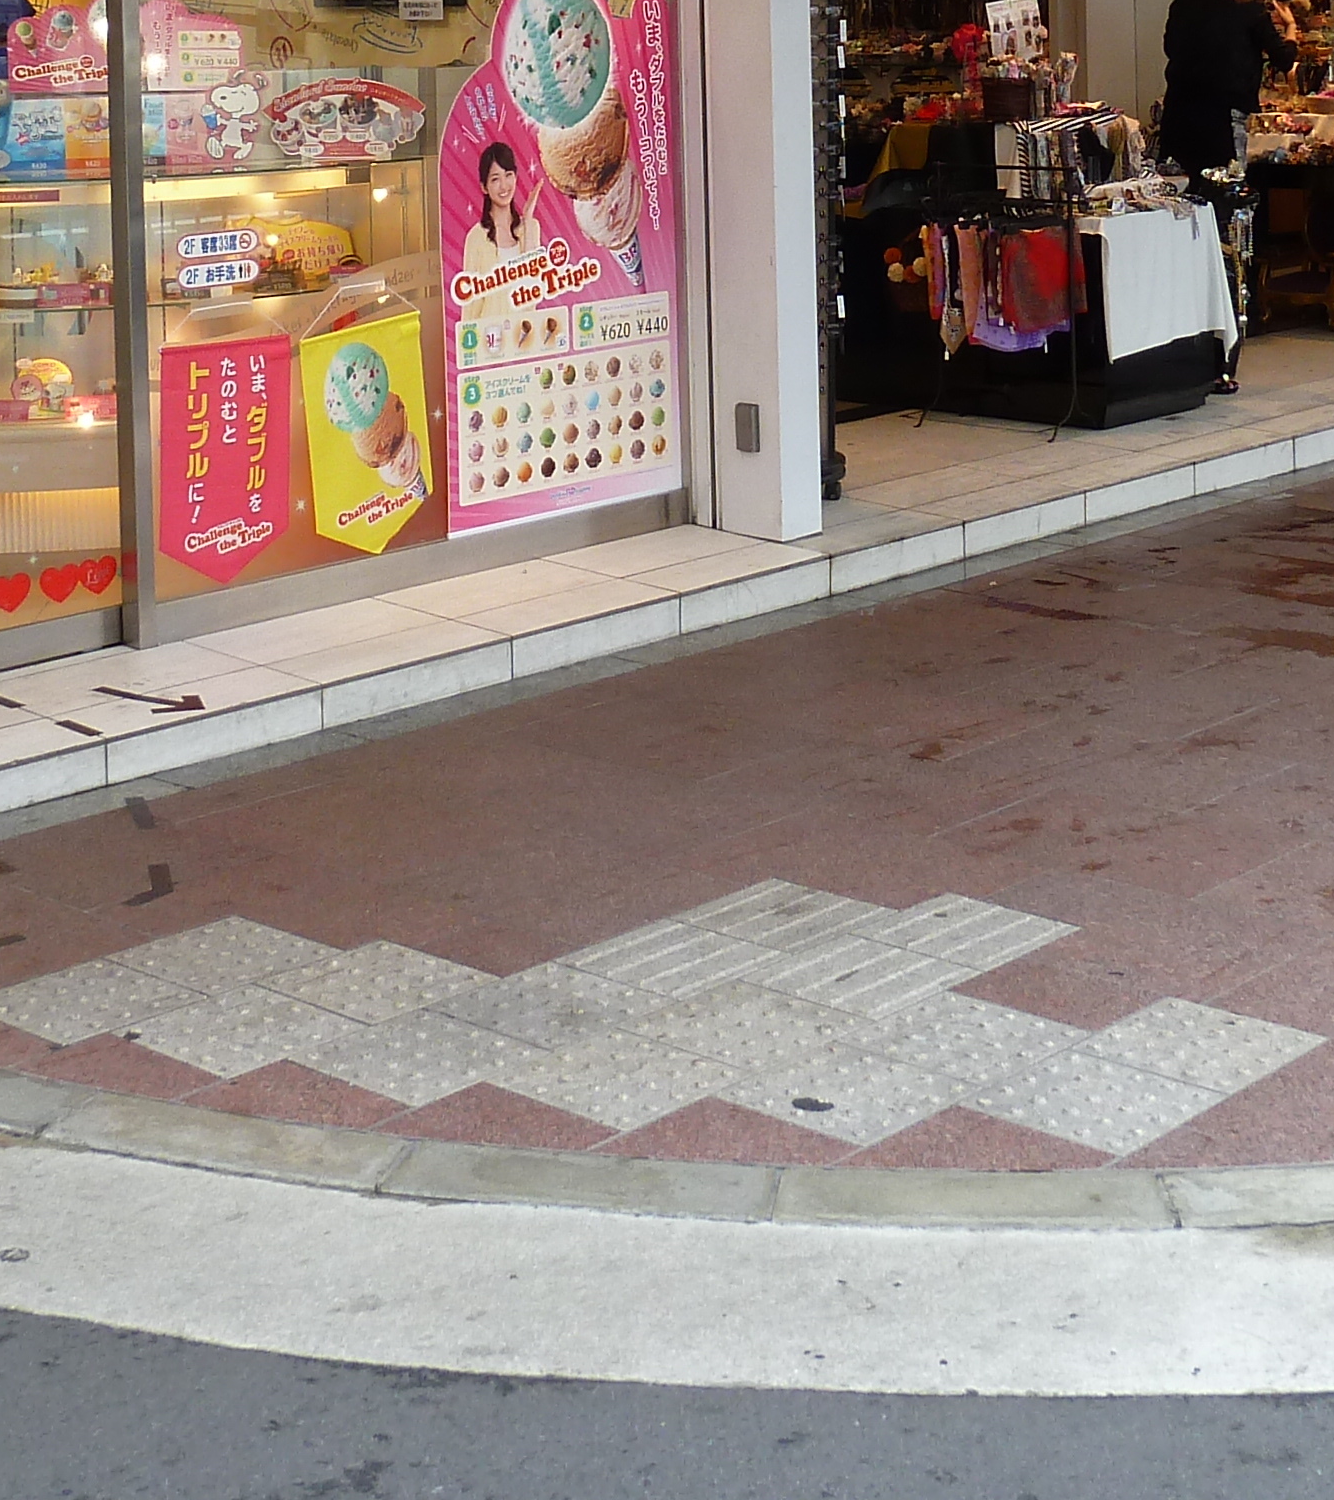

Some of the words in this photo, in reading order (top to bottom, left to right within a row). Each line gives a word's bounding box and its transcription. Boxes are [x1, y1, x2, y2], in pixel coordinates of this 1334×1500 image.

[15, 61, 79, 79] Challenge
[52, 74, 75, 85] the
[183, 238, 196, 256] 2F
[200, 234, 238, 255] 客席33席
[185, 268, 199, 285] 2F
[205, 265, 236, 284] お手洗
[455, 254, 548, 301] Challenge
[511, 284, 541, 306] the
[541, 261, 599, 295] Triple
[600, 322, 631, 341] ¥620
[636, 315, 668, 335] ¥440
[219, 356, 238, 445] たのむと
[186, 361, 211, 525] トリプルに！
[246, 353, 268, 514] いま、ダブルを
[337, 493, 386, 526] Challenge
[366, 509, 384, 524] the
[382, 491, 414, 516] Triple
[186, 521, 244, 551] Challenge
[218, 537, 238, 553] the
[237, 523, 272, 546] Triple
